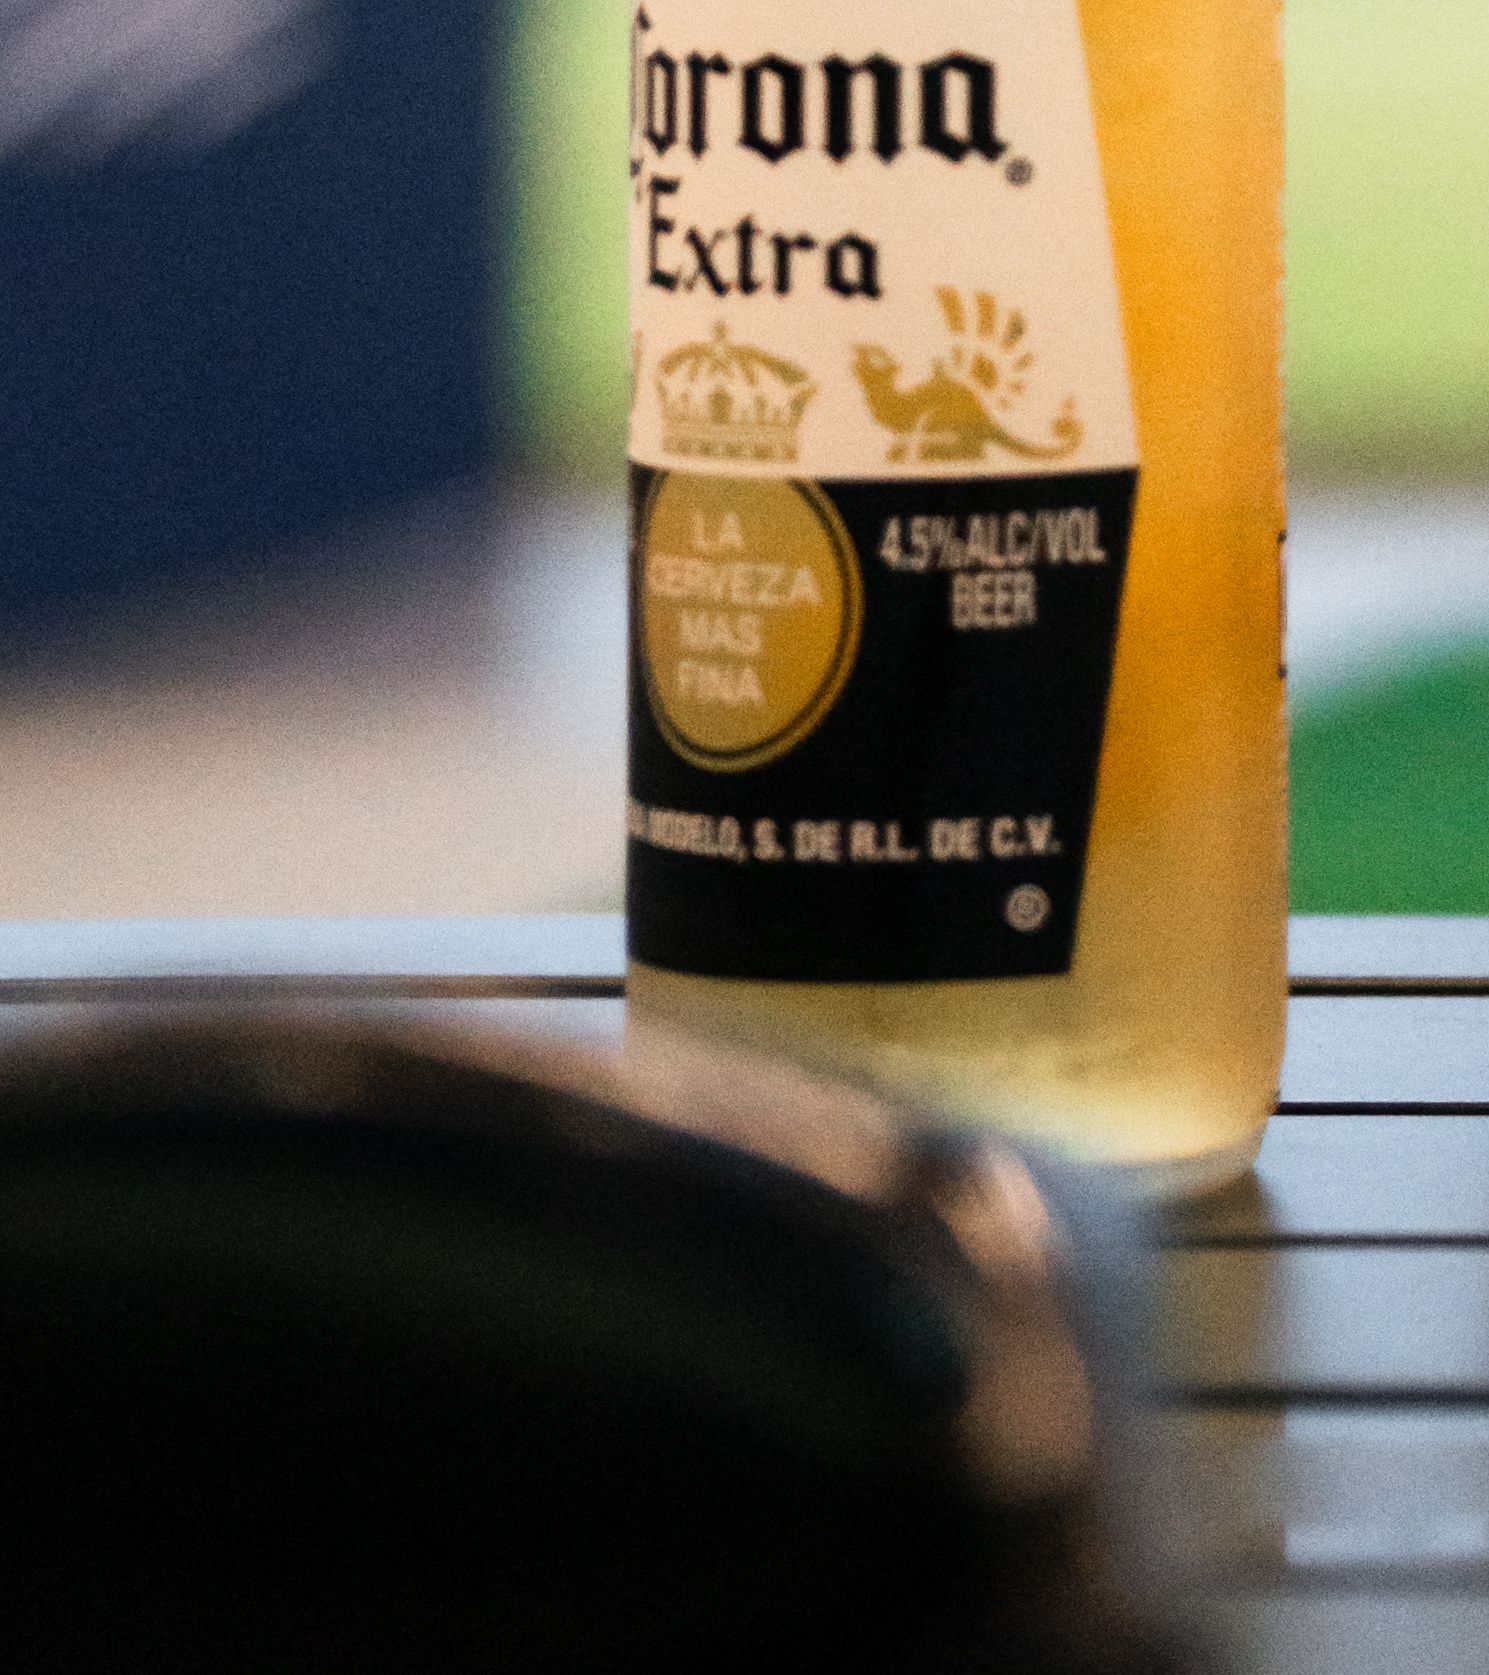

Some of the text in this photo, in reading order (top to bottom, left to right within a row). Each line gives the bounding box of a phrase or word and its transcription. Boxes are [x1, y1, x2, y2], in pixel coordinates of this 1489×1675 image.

[647, 175, 883, 301] Extra
[691, 511, 745, 554] LA
[951, 569, 1038, 632] BEER
[679, 610, 764, 657] MAS
[793, 818, 842, 864] DE
[928, 816, 981, 864] DE
